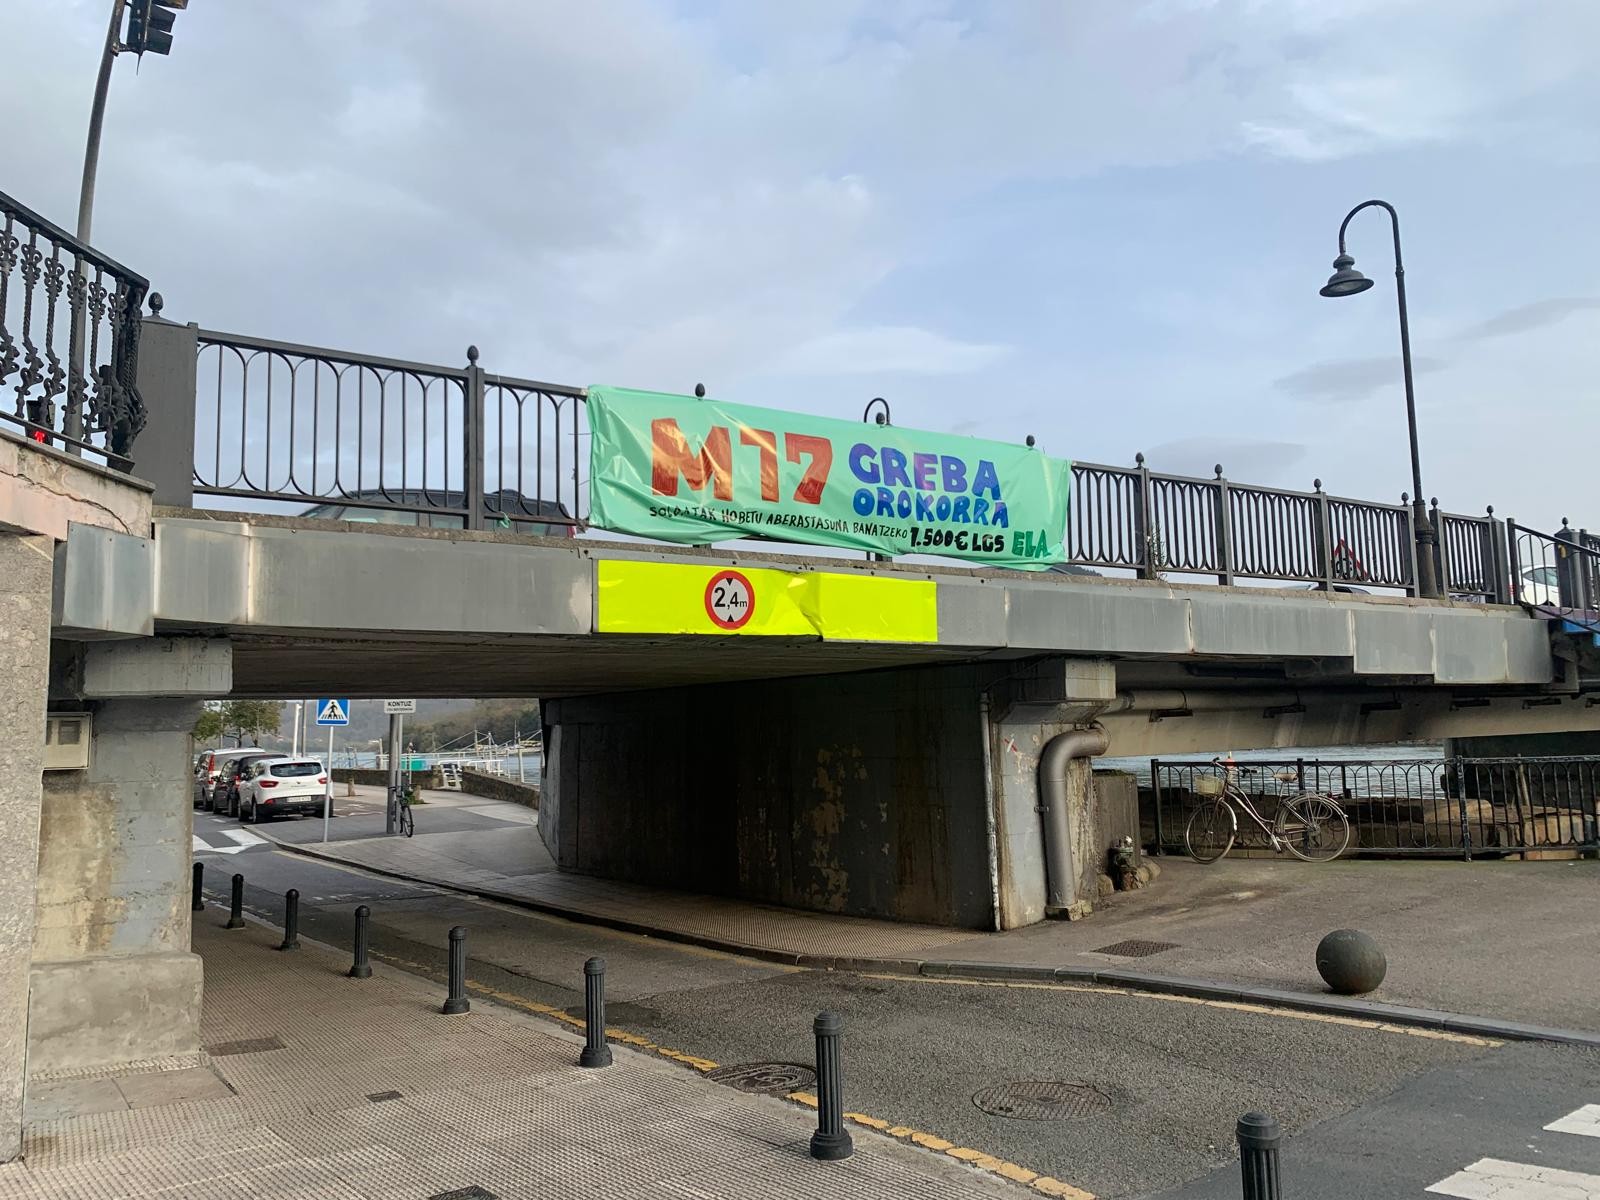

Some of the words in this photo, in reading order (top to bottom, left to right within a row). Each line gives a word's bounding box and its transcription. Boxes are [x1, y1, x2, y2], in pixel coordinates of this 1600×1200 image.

[652, 417, 833, 505] M17
[848, 443, 1002, 500] GREBA
[721, 508, 763, 525] HOBETU
[766, 513, 849, 533] ABERASTASUNA
[853, 522, 908, 539] BANATZEKO
[853, 487, 1009, 528] OROKORRA
[910, 526, 969, 551] 1.500€
[972, 533, 1005, 552] LGS
[1011, 529, 1052, 558] ELA
